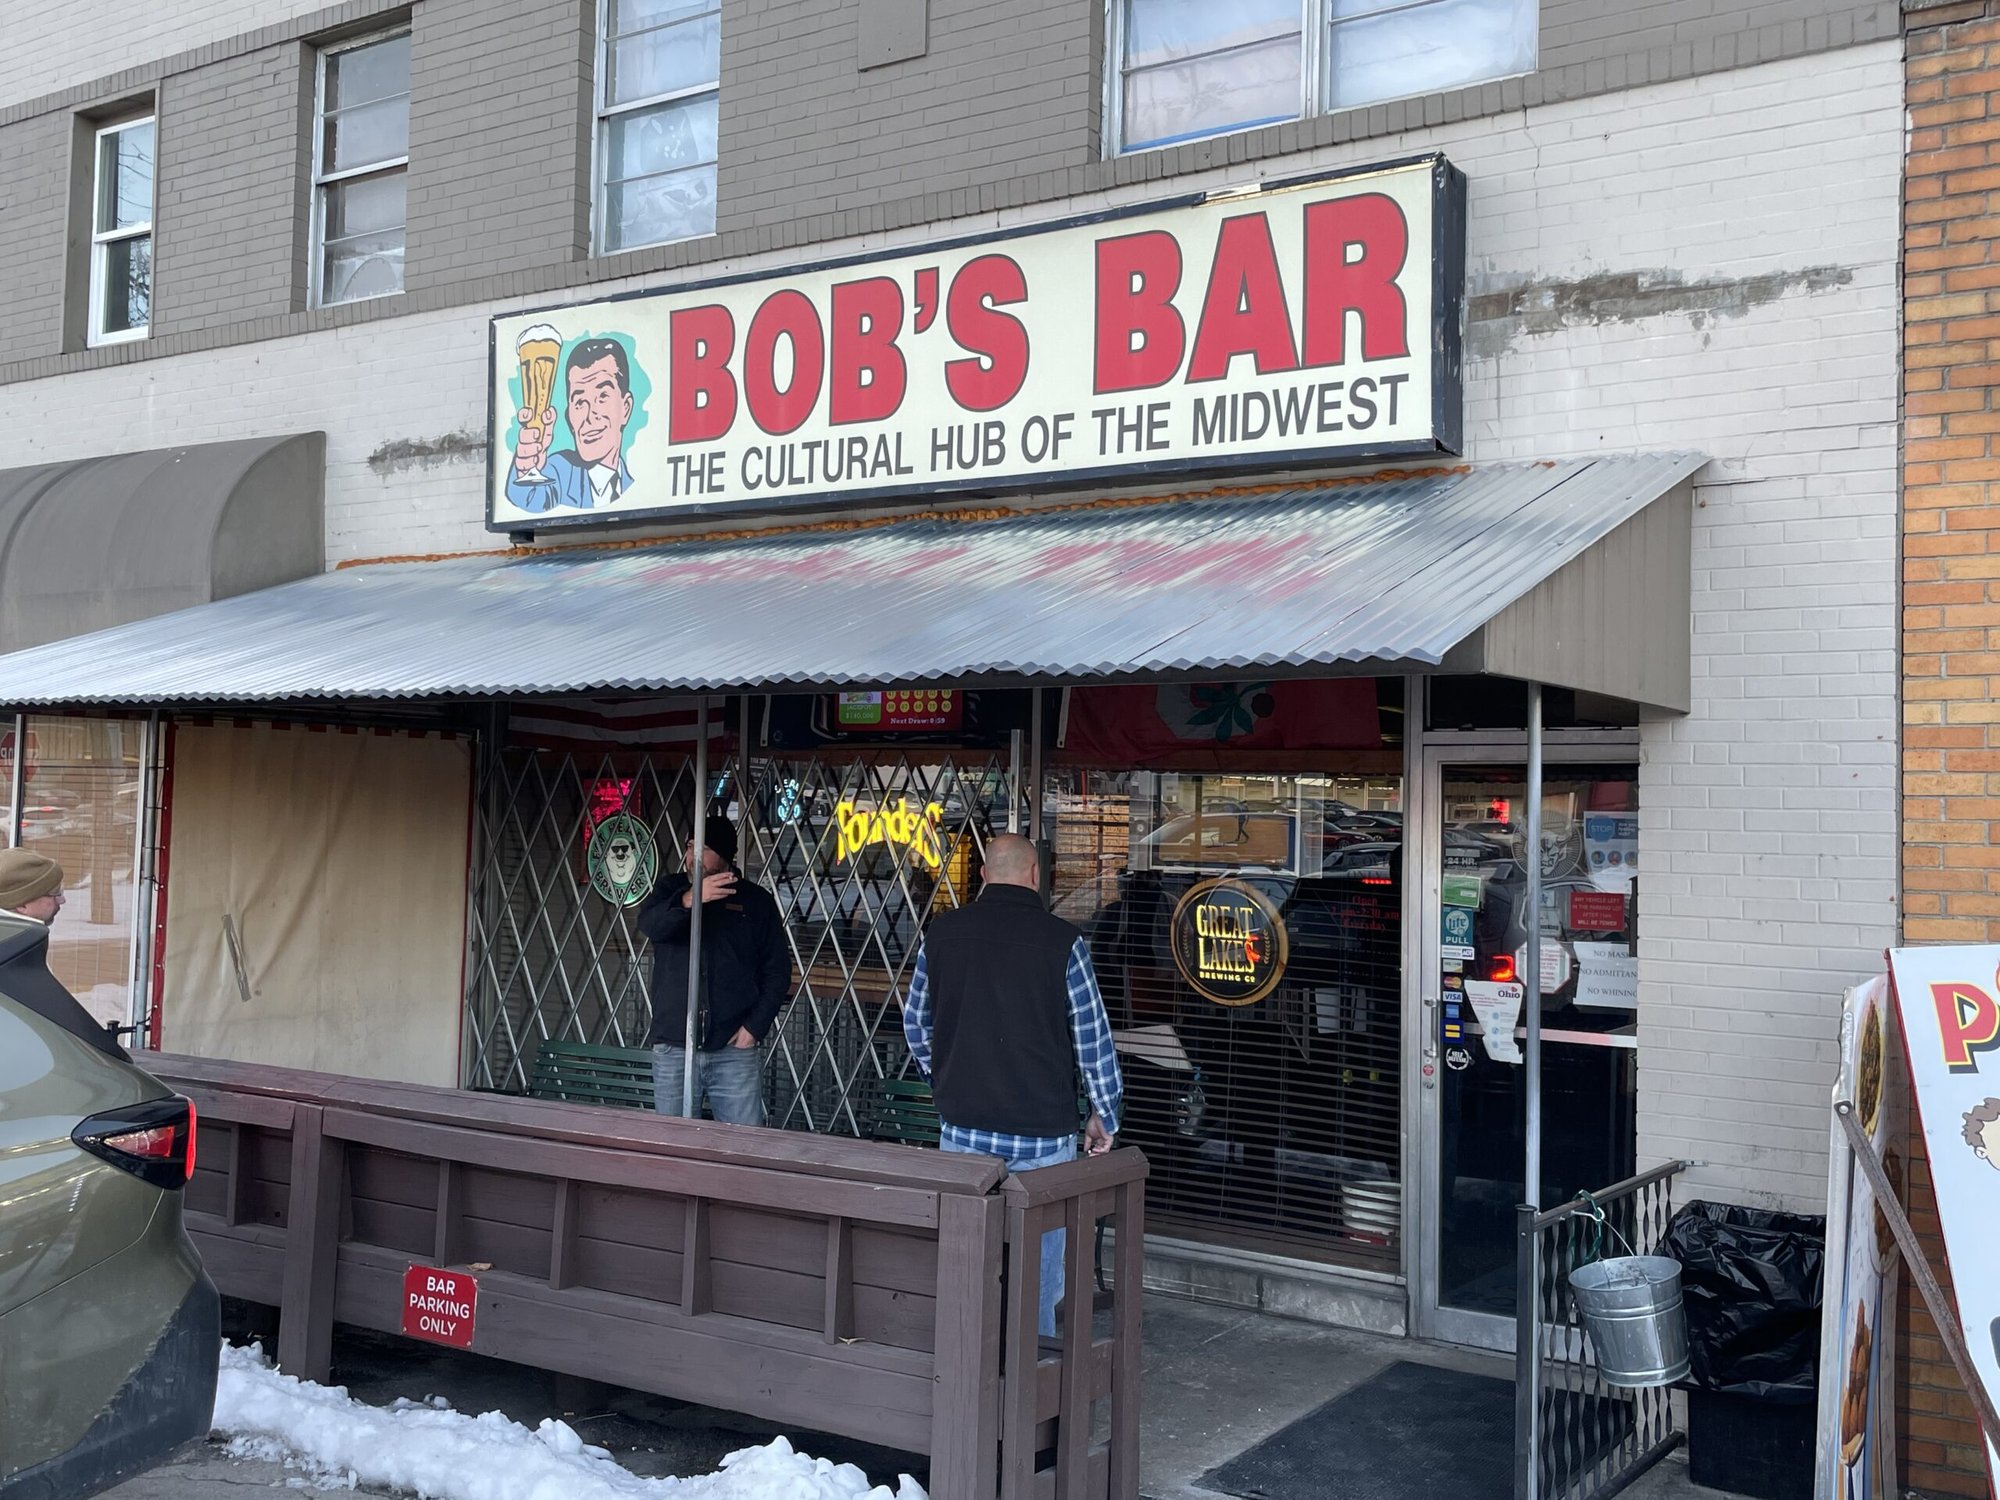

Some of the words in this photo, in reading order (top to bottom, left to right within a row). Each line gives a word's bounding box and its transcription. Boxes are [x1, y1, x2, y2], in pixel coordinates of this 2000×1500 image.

[669, 253, 1030, 446] BOB'S
[1093, 192, 1411, 396] BAR
[667, 451, 726, 496] THE
[741, 432, 913, 490] CULTURAL
[930, 420, 1006, 472] HUB
[1021, 412, 1075, 463] OF
[1092, 401, 1171, 456] THE
[1192, 373, 1410, 447] MIDWEST
[1591, 824, 1612, 833] STOP
[1447, 857, 1459, 865] 24
[1196, 904, 1253, 939] GREAT
[1445, 936, 1469, 944] PULL
[1198, 937, 1255, 974] LAKES
[1199, 971, 1241, 981] BREWING
[1498, 989, 1521, 999] Ohio
[1587, 987, 1600, 995] NO
[426, 1276, 456, 1296] BAR
[409, 1293, 470, 1319] PARKING
[419, 1316, 457, 1337] ONLY
